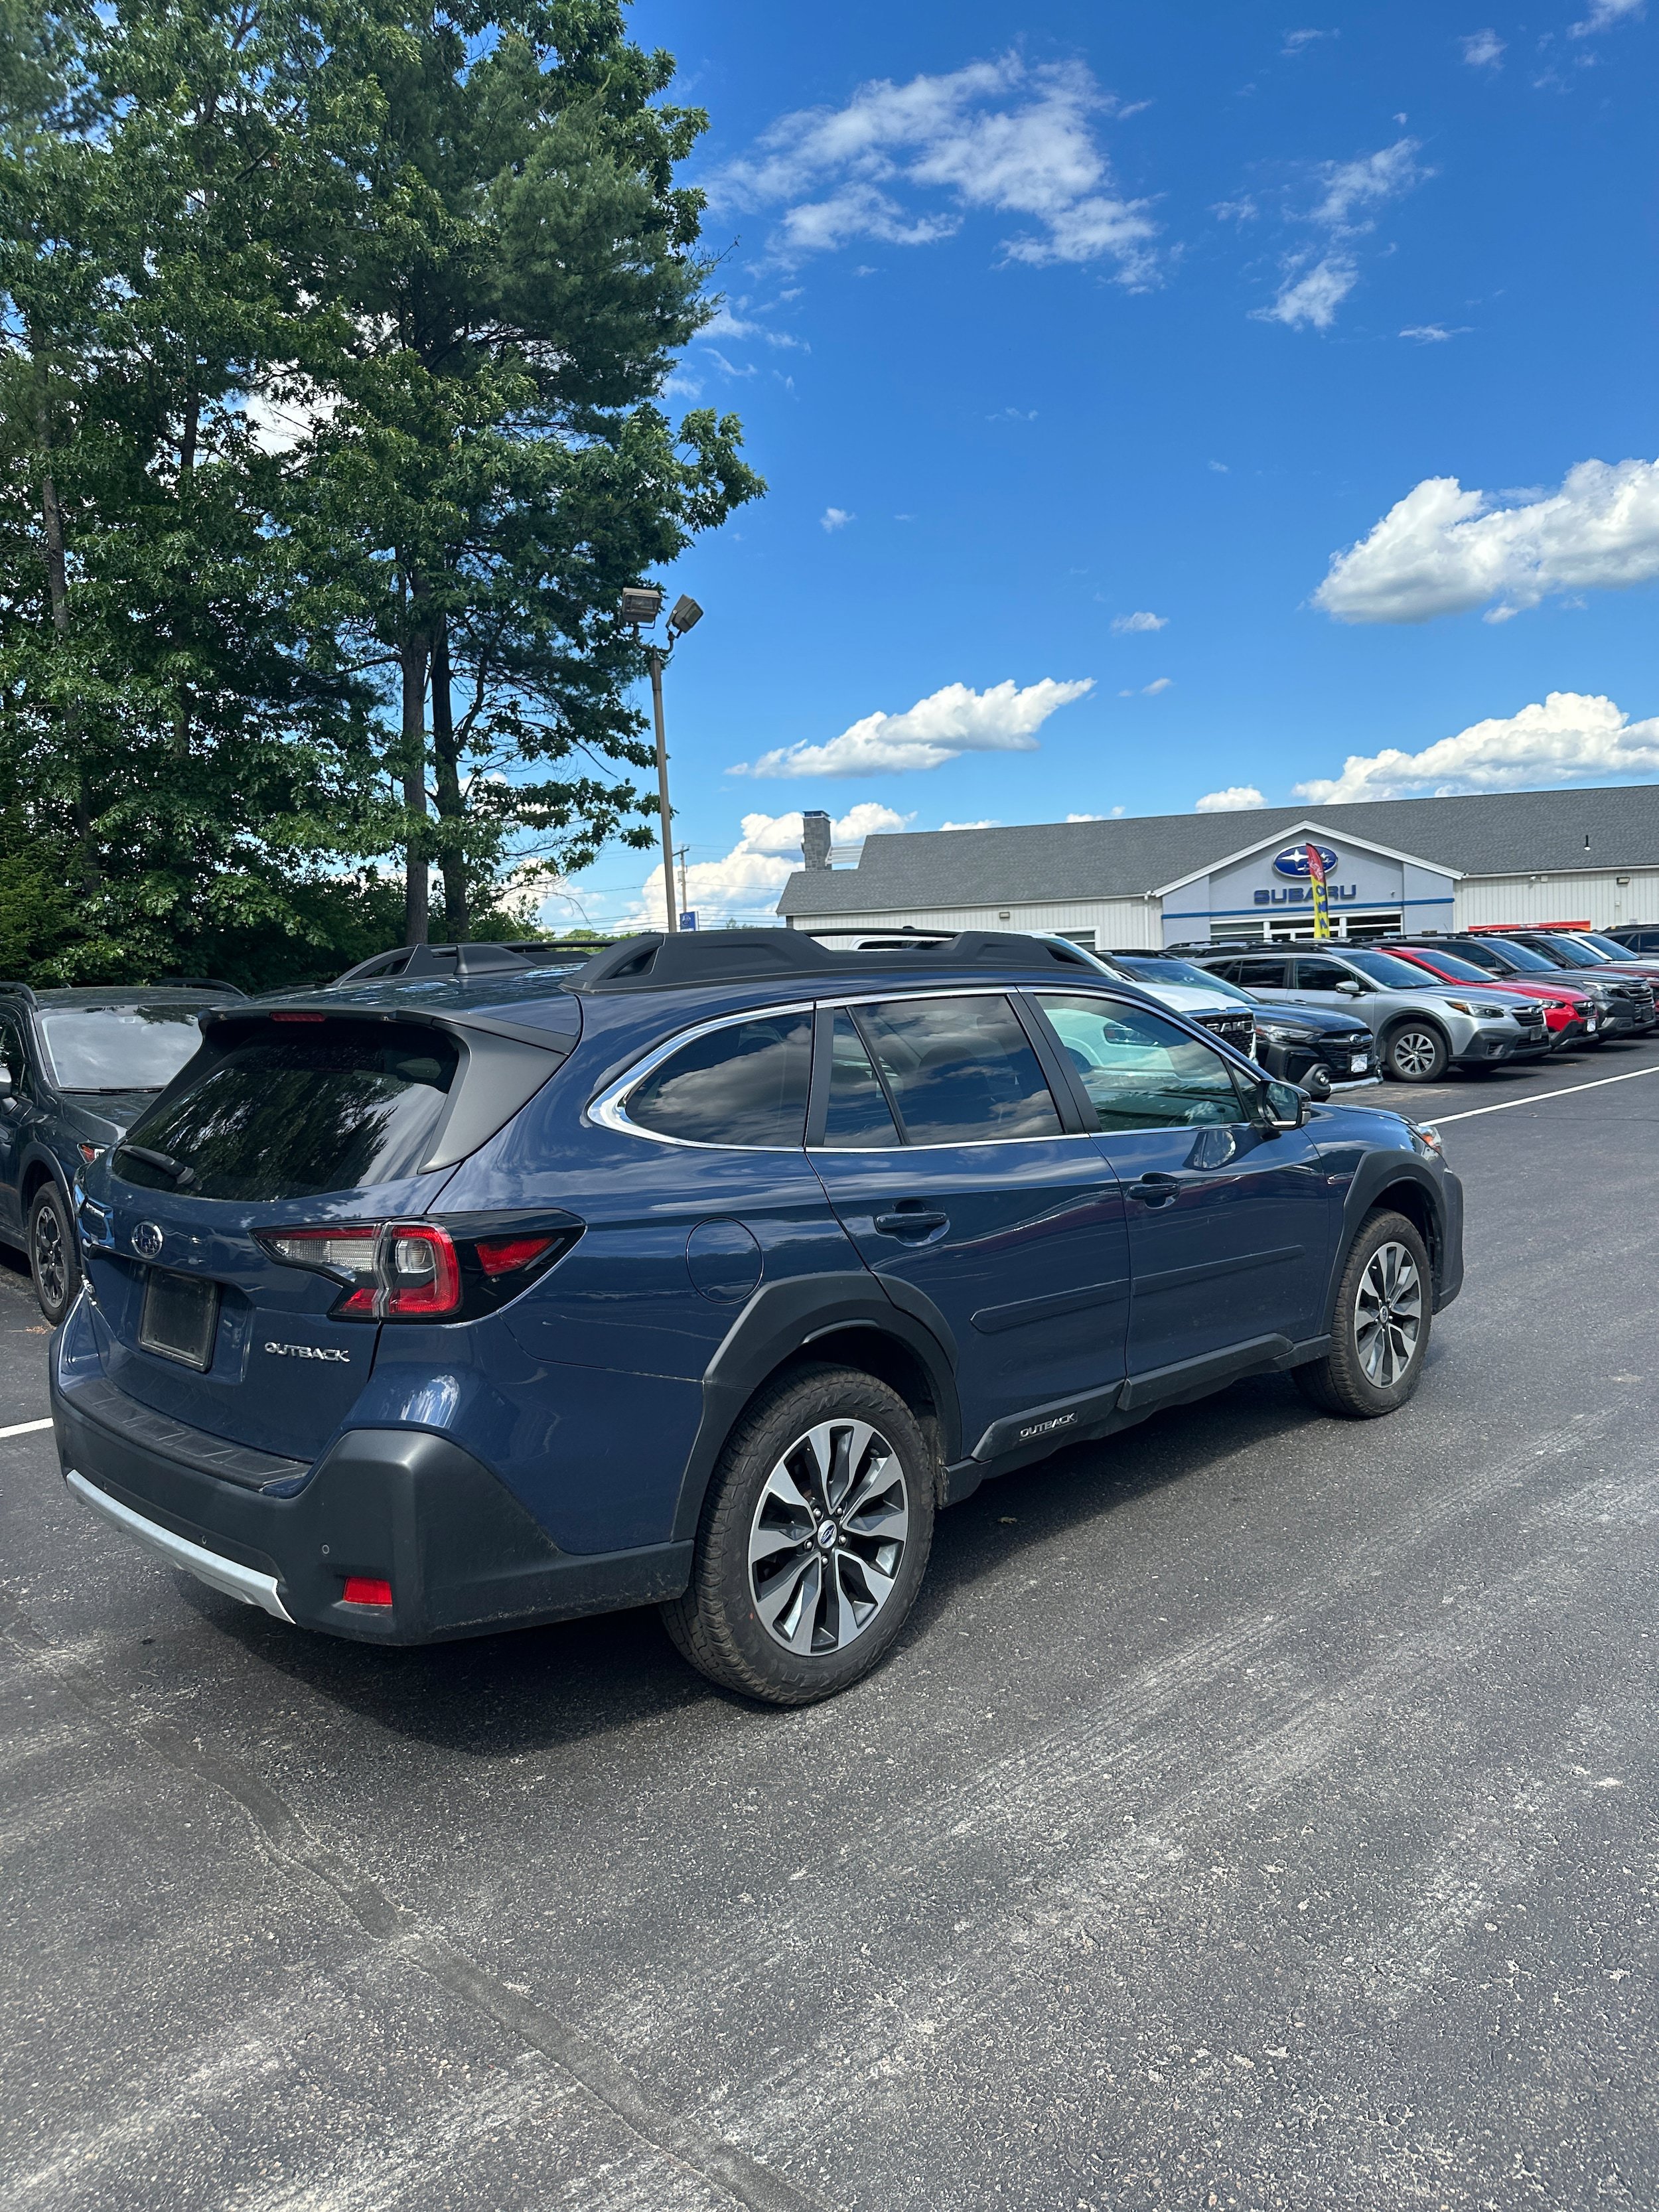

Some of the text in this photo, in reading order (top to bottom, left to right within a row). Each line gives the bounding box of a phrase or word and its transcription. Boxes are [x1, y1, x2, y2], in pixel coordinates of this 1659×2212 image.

[1206, 1022, 1245, 1033] RAM
[264, 1341, 350, 1363] OUTBACK
[1020, 1412, 1076, 1438] OUTBACK
